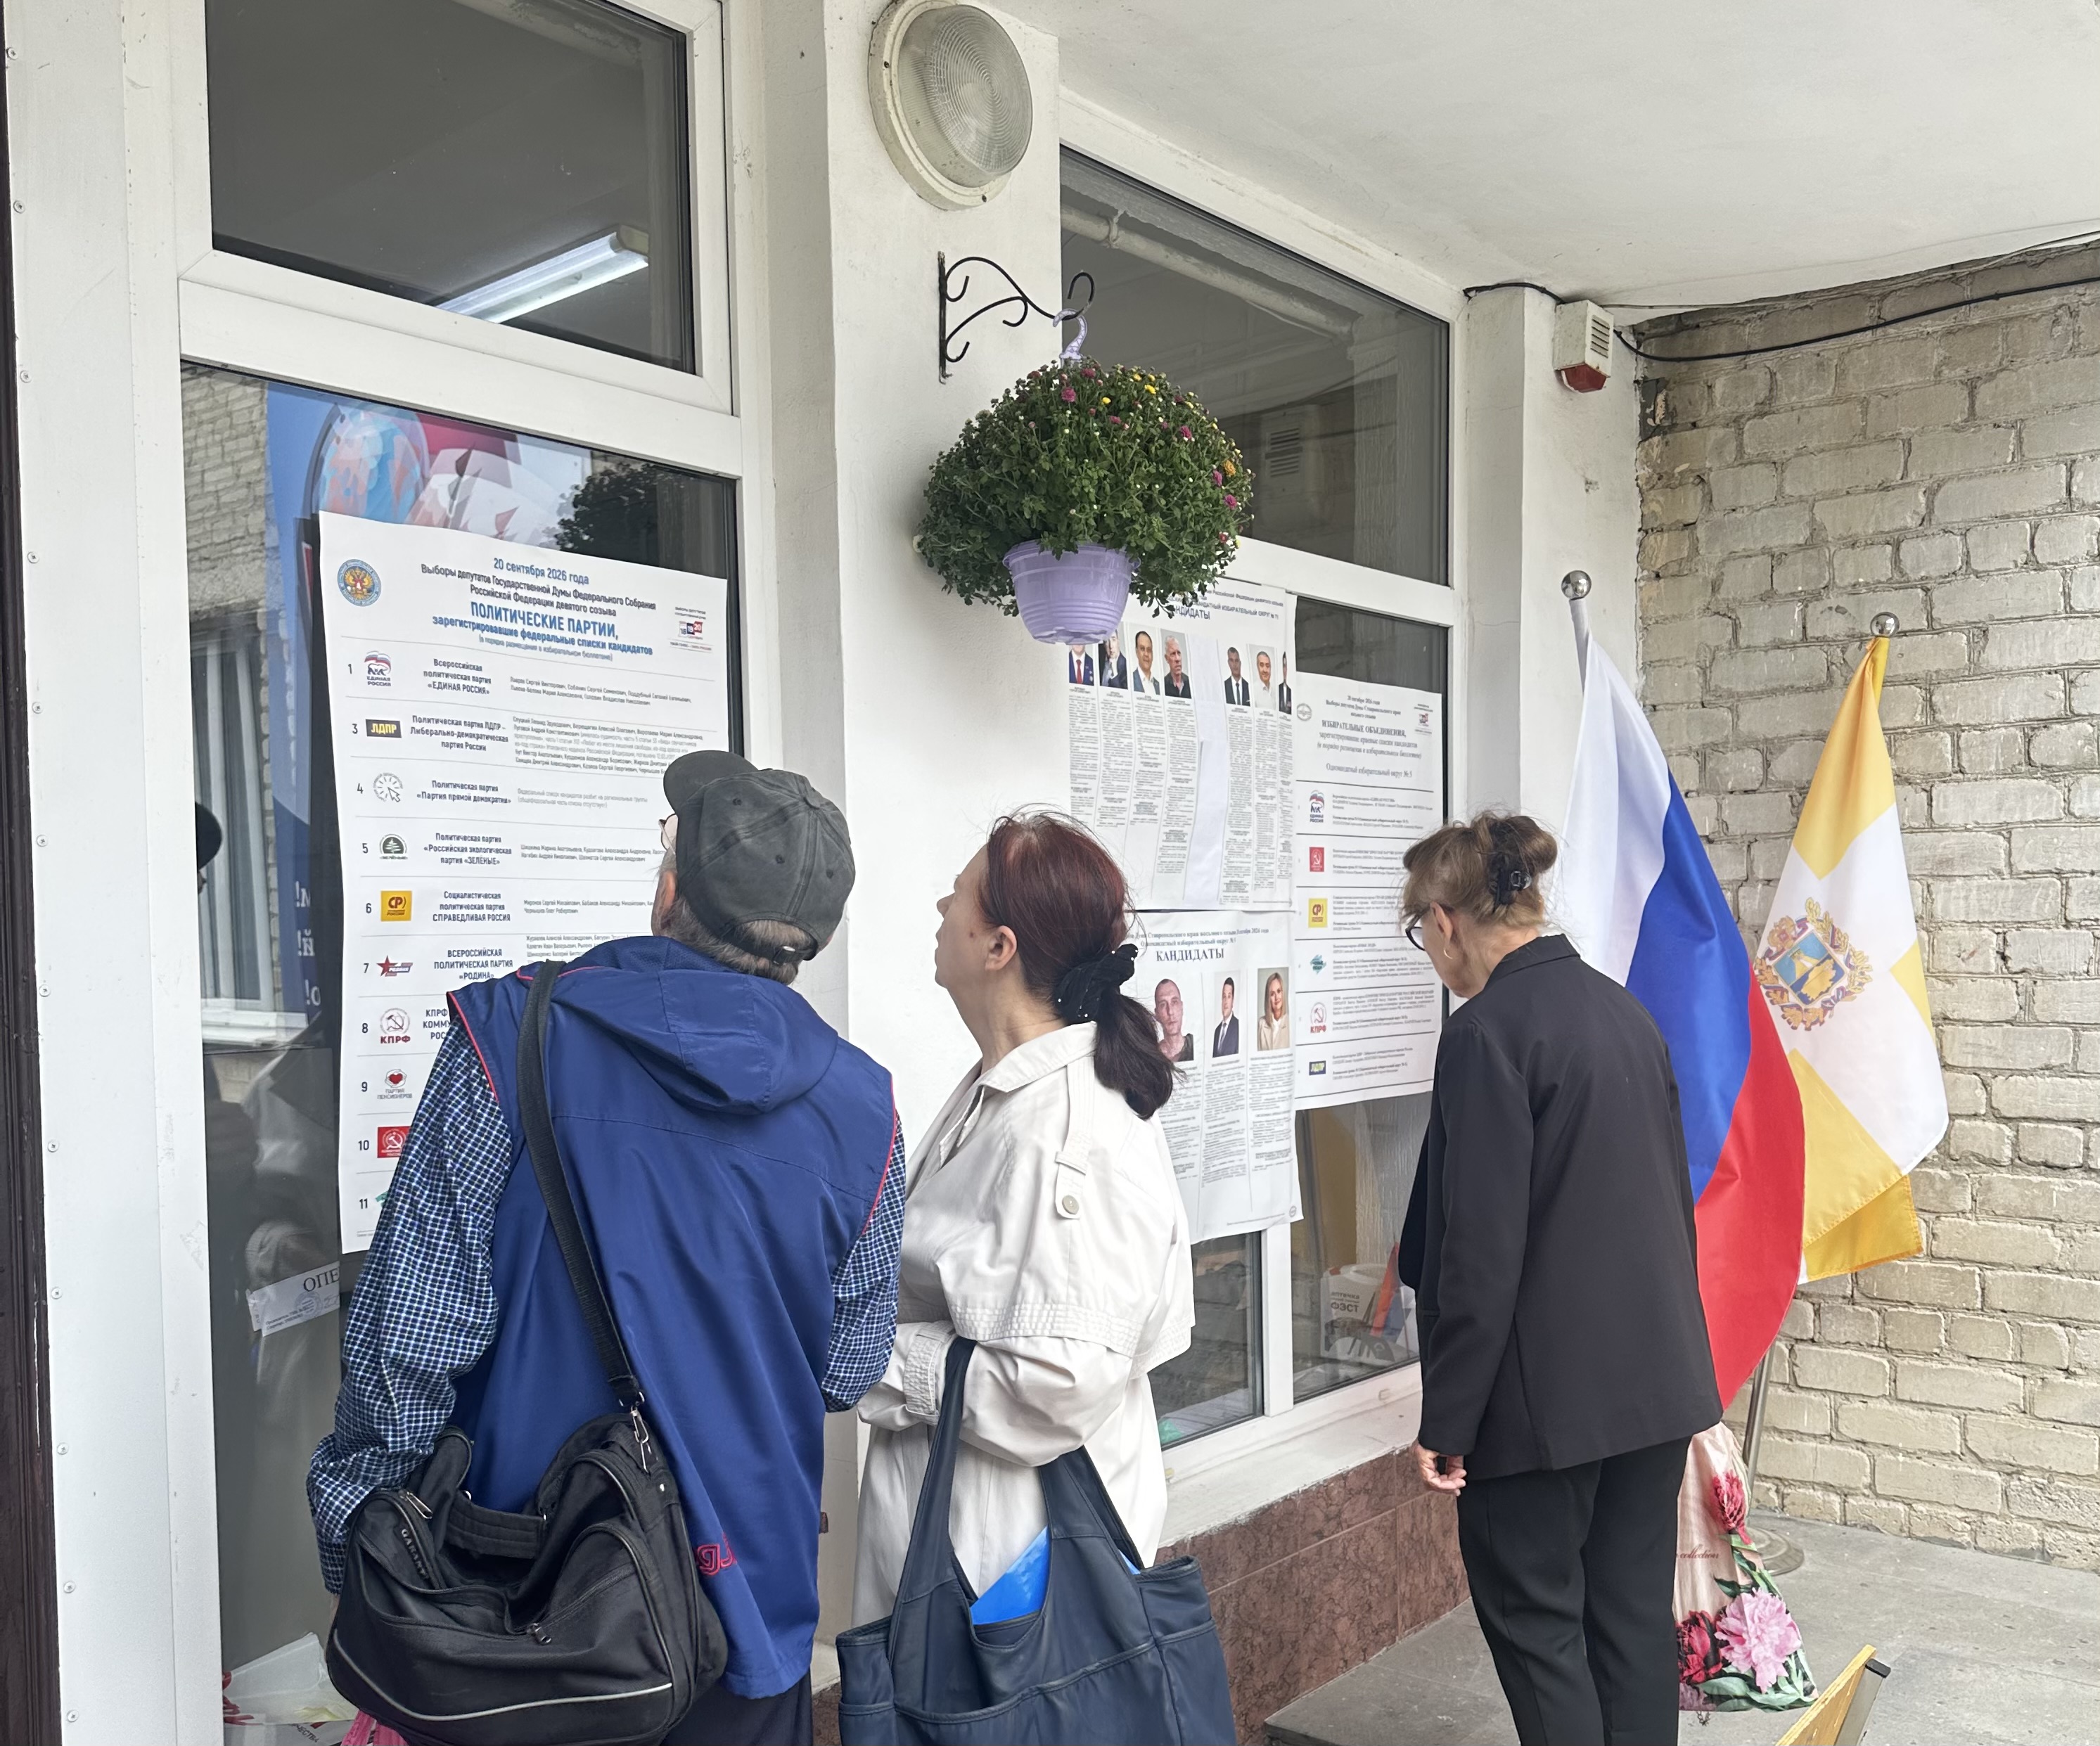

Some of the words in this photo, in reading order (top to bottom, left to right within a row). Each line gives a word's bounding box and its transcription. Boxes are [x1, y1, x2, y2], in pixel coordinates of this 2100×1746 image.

[494, 558, 504, 570] 20
[506, 563, 545, 578] сентября
[547, 567, 567, 581] 2026
[570, 574, 589, 585] года
[421, 564, 456, 577] Выборы
[458, 570, 491, 584] депутатов
[492, 575, 550, 593] Государственной
[552, 586, 571, 598] Думы
[572, 589, 624, 605] Федерального
[625, 598, 655, 610] Собрания
[470, 584, 511, 601] Российской
[513, 592, 554, 607] Федерации
[556, 601, 587, 612] девятого
[589, 606, 616, 616] созыва
[471, 601, 564, 631] ПОЛИТИЧЕСКИЕ
[568, 618, 618, 640] ПАРТИИ,
[433, 616, 518, 637] зарегистрировавшие
[520, 629, 575, 646] федеральные
[577, 638, 606, 649] списки
[608, 643, 653, 655] кандидатов
[348, 664, 352, 674] 1
[434, 659, 482, 672] Всероссийская
[423, 671, 470, 681] политическая
[472, 676, 491, 684] партия
[428, 681, 461, 691] «ЕДИНАЯ
[462, 684, 489, 694] РОССИЯ»
[412, 715, 462, 726] Политическая
[485, 721, 501, 731] ЛДПР
[352, 724, 358, 734] 3
[371, 724, 397, 734] ЛДПР
[411, 726, 508, 742] Либерально-демократическая
[465, 742, 486, 751] России
[357, 783, 363, 794] 4
[432, 781, 478, 790] Политическая
[417, 791, 447, 801] «Партия
[436, 833, 480, 842] Политическая
[362, 843, 368, 854] 5
[444, 891, 501, 899] Социалистическая
[366, 903, 371, 913] 6
[448, 948, 502, 957] ВСЕРОССИЙСКАЯ
[1156, 949, 1224, 962] КАНДИДАТЫ
[364, 963, 369, 973] 7
[434, 961, 488, 969] ПОЛИТИЧЕСКАЯ
[459, 970, 494, 981] «РОДИНА»
[425, 1009, 447, 1018] КПРФ
[362, 1023, 368, 1033] 8
[361, 1081, 367, 1092] 9
[359, 1140, 369, 1150] 10
[359, 1198, 367, 1209] 11
[1331, 1302, 1359, 1312] ФЭСТ
[1680, 1544, 1719, 1559] collection
